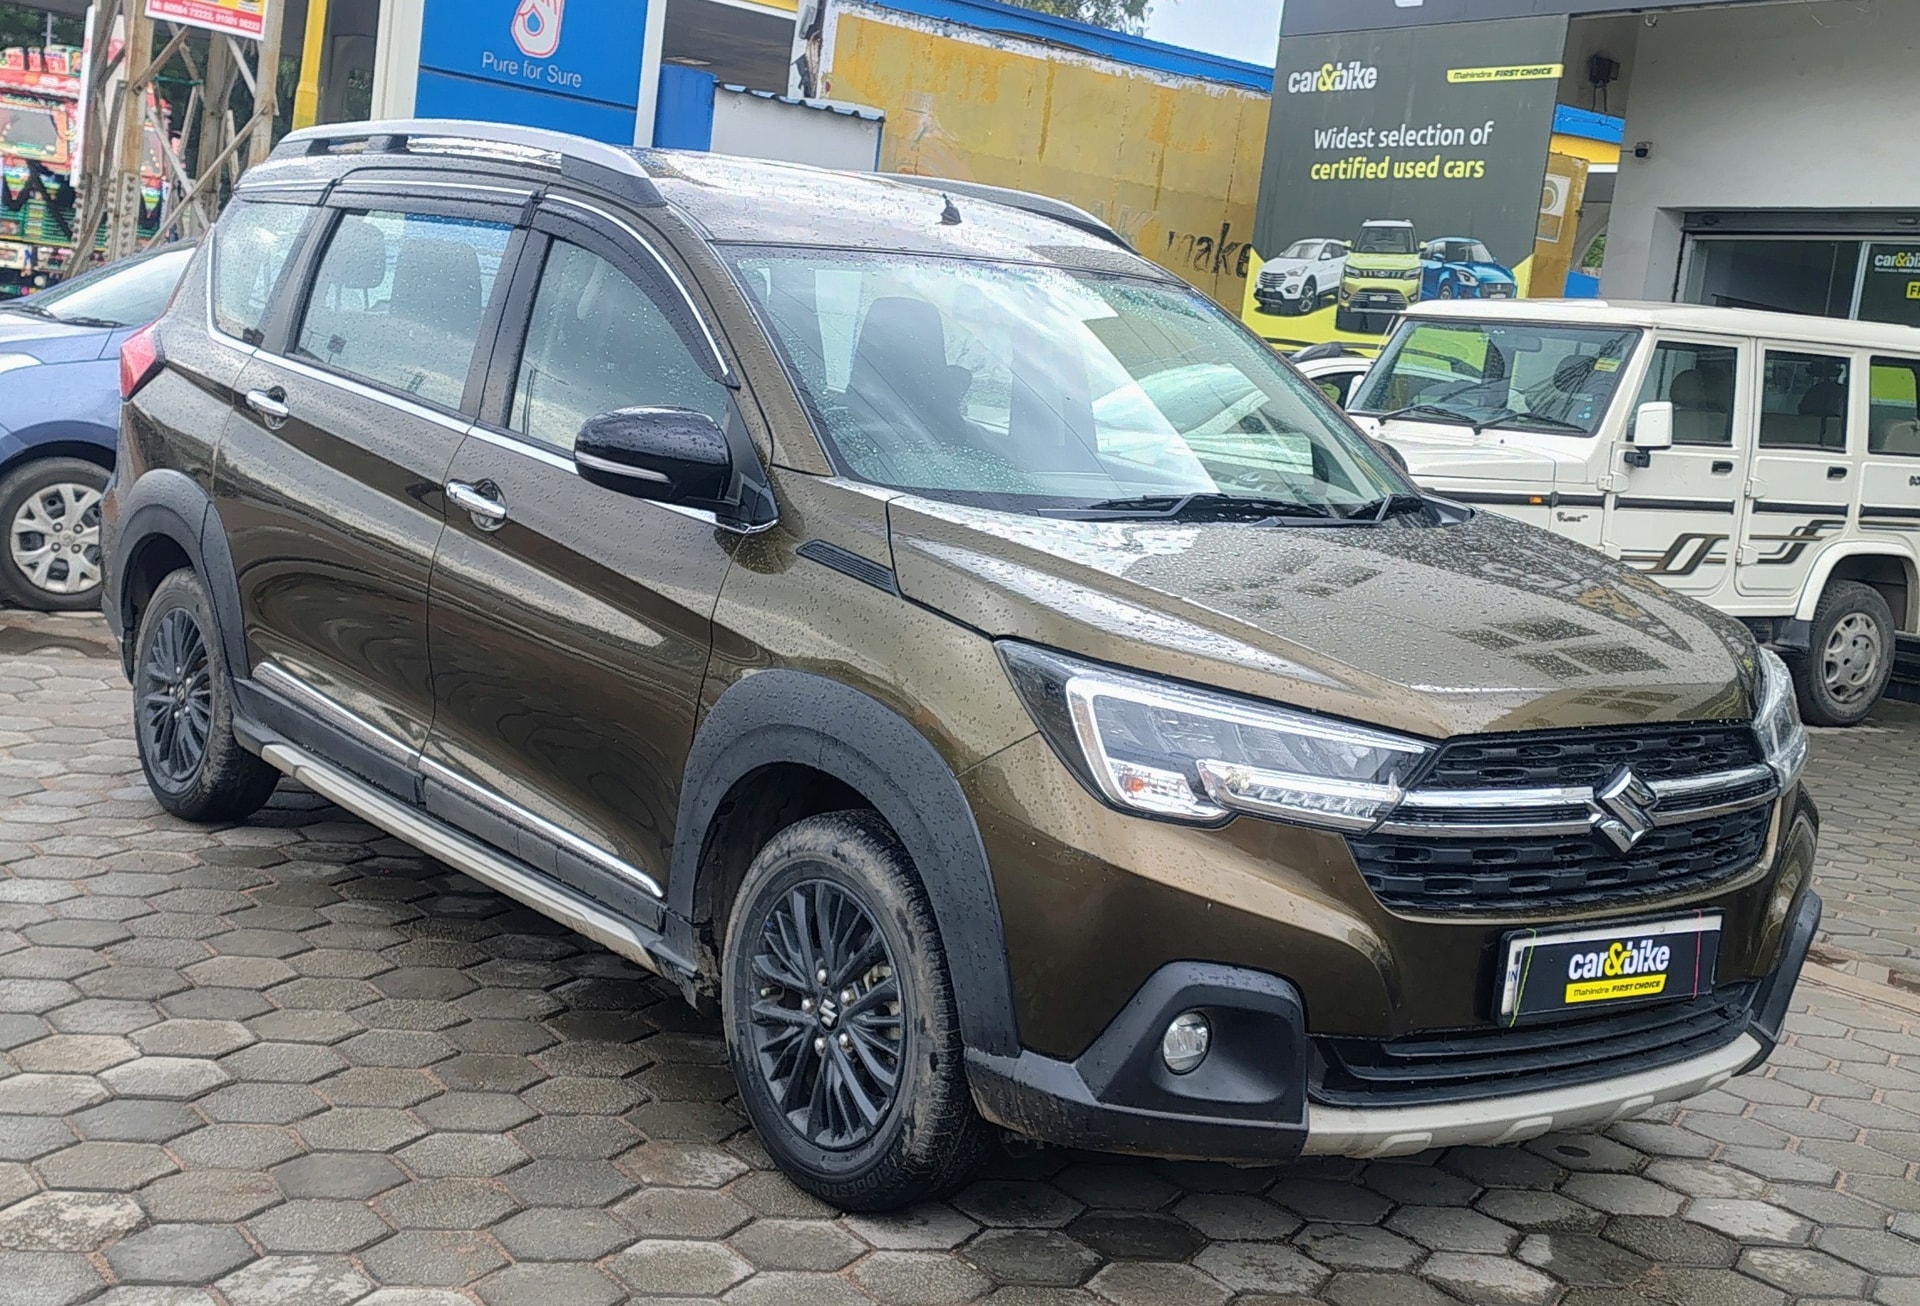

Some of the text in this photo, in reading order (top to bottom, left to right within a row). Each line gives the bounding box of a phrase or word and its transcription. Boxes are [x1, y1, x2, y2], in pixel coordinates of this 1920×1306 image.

[482, 51, 582, 88] Pure for Sure
[1288, 61, 1377, 93] car&bike
[1453, 67, 1553, 80] Mahindra FIRST CHOICE
[1314, 121, 1494, 149] Widest selection of
[1310, 155, 1485, 180] certified used cars
[1874, 252, 1920, 268] car&bi
[1568, 939, 1670, 980] car&bike
[1573, 980, 1661, 997] Mahindra FIRST CHOICE
